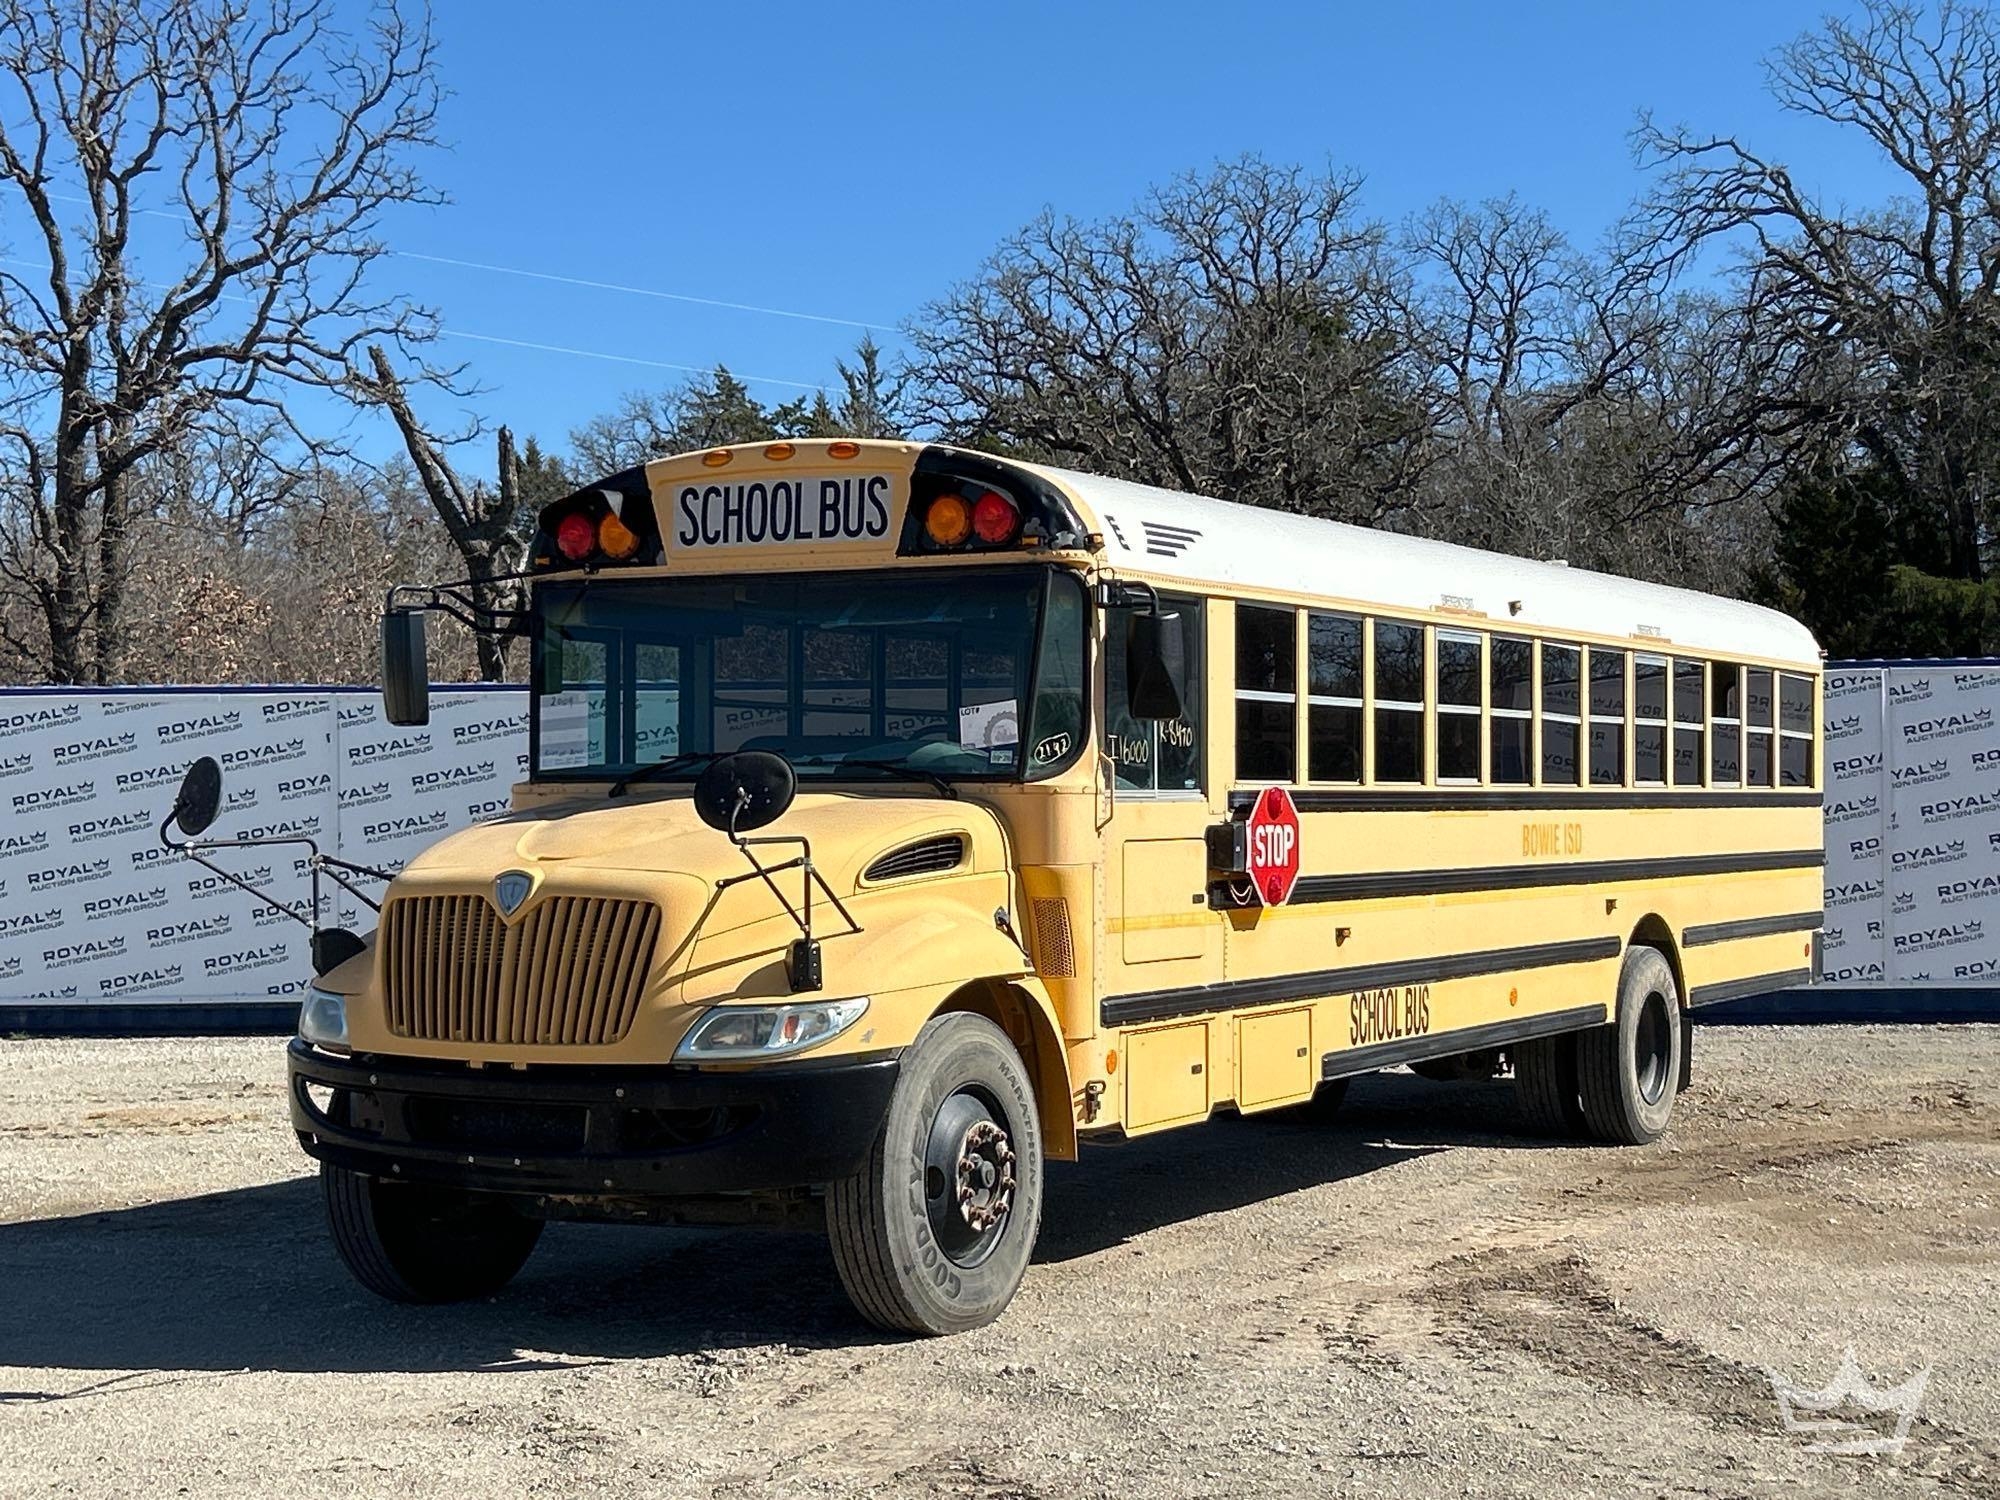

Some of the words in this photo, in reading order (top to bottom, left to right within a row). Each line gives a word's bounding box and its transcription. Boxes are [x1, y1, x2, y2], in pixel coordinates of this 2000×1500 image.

[679, 481, 813, 546] SCHOOL
[818, 476, 889, 539] BUS
[1958, 678, 2000, 691] AUCTIO
[1895, 691, 1933, 704] GROUP
[0, 708, 62, 729] ROYAL
[104, 702, 149, 716] AUCTION
[266, 710, 310, 724] AUCTION
[726, 707, 786, 724] ROYA
[0, 723, 45, 737] AUCTION
[46, 715, 81, 728] GROUP
[157, 716, 223, 736] ROYAL
[341, 716, 377, 728] GROUP
[453, 717, 519, 738] ROYAL
[888, 716, 948, 732] ROYA
[1903, 714, 1974, 736] ROYAL
[160, 731, 205, 744] AUCTION
[206, 723, 242, 736] GROUP
[456, 732, 501, 746] AUCTION
[1824, 728, 1863, 741] GROUP
[1907, 729, 1954, 744] AUCTION
[1956, 721, 1994, 734] GROUP
[53, 737, 119, 758] ROYAL
[56, 752, 101, 766] AUCTION
[102, 744, 138, 757] GROUP
[221, 743, 287, 764] ROYAL
[348, 738, 414, 758] ROYAL
[352, 753, 396, 766] AUCTION
[397, 745, 433, 758] GROUP
[224, 758, 269, 772] AUCTION
[270, 750, 306, 763] GROUP
[1833, 752, 1883, 772] ROY
[116, 765, 182, 786] ROYAL
[412, 766, 478, 786] ROYAL
[1891, 765, 1930, 780] YAL
[1912, 771, 1951, 785] GROUP
[120, 780, 164, 794] AUCTION
[166, 774, 188, 784] GRO
[278, 774, 331, 793] ROYA
[281, 786, 326, 801] AUCTION
[338, 786, 373, 801] YAL
[416, 781, 460, 794] AUCTION
[461, 773, 497, 786] GROUP
[12, 786, 78, 806] ROYAL
[16, 801, 60, 814] AUCTION
[61, 793, 97, 806] GROUP
[357, 794, 392, 806] GROUP
[1920, 794, 1991, 816] ROYAL
[468, 798, 509, 815] ROY
[1823, 801, 1859, 816] YAL
[1842, 808, 1880, 821] GROUP
[1924, 809, 1972, 824] AUCTION
[1973, 804, 2000, 815] GRO
[68, 815, 134, 836] ROYAL
[72, 830, 116, 844] AUCTION
[117, 822, 153, 835] GROUP
[237, 820, 303, 841] ROYAL
[363, 816, 429, 836] ROYAL
[366, 830, 411, 844] AUCTION
[412, 822, 448, 835] GROUP
[14, 843, 50, 856] GROUP
[1255, 824, 1294, 868] STOP
[1523, 824, 1560, 856] BOWIE
[1564, 823, 1582, 854] ISD
[131, 847, 187, 863] ROYA
[134, 856, 179, 871] AUCTION
[181, 850, 217, 861] GOUP
[1853, 849, 1883, 860] AUCT
[1892, 845, 1947, 863] OYAL
[1892, 860, 1928, 872] CTION
[1930, 852, 1967, 865] GROUP
[27, 863, 93, 884] ROYAL
[30, 878, 75, 892] AUCTION
[76, 870, 112, 883] GROUP
[192, 886, 236, 899] AUCTION
[1824, 881, 1876, 899] OYAL
[1937, 874, 2000, 896] ROYA
[84, 892, 150, 912] ROYAL
[1824, 896, 1857, 908] CTION
[1859, 891, 1883, 901] GRO
[1940, 890, 1989, 904] AUCTION
[88, 907, 132, 920] AUCTION
[133, 899, 169, 912] GROUP
[1892, 904, 1916, 914] OUP
[0, 913, 46, 930] OYAL
[0, 927, 28, 939] TION
[29, 920, 64, 933] GROUP
[147, 920, 213, 940] ROYAL
[150, 935, 195, 948] AUCTION
[196, 927, 232, 940] GROUP
[1823, 940, 1846, 950] OUP
[1893, 925, 1964, 947] ROYAL
[1896, 940, 1944, 955] AUCTION
[1946, 933, 1985, 946] GROUP
[43, 941, 109, 962] ROYAL
[46, 956, 91, 970] AUCTION
[92, 948, 128, 961] GROUP
[204, 948, 270, 968] ROYAL
[208, 963, 252, 976] AUCTION
[253, 955, 289, 968] GROUP
[1954, 959, 1998, 977] ROY
[99, 970, 165, 990] ROYAL
[102, 985, 147, 998] AUCTION
[148, 976, 184, 990] GROUP
[268, 979, 308, 995] ROY
[1350, 988, 1402, 1046] SCHOOL
[1406, 985, 1429, 1035] BUS
[999, 1061, 1036, 1186] MARATHON
